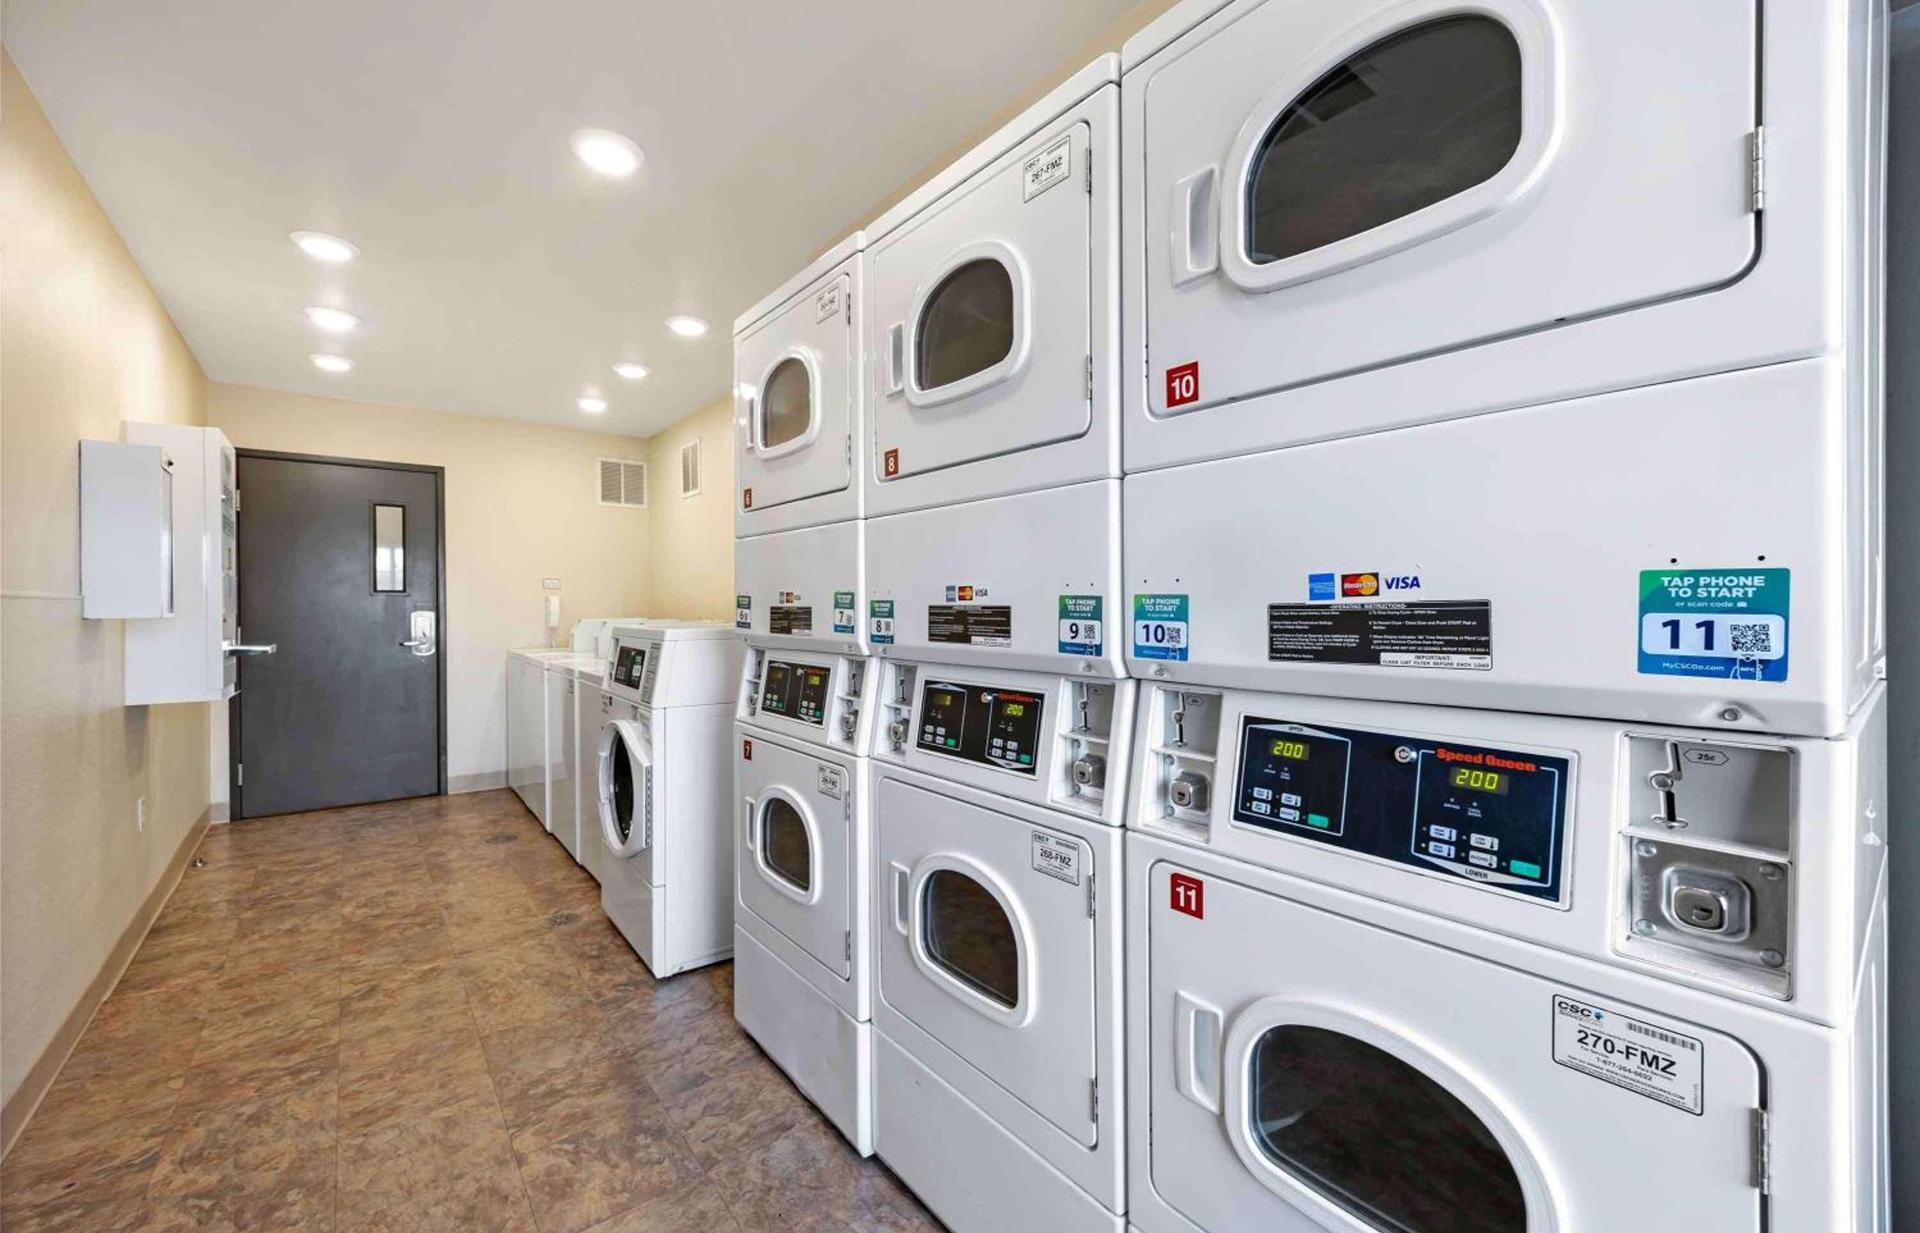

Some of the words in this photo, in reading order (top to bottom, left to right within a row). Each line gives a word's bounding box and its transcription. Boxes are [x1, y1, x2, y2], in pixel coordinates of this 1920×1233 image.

[1171, 375, 1194, 400] 10
[888, 457, 895, 472] 8
[1385, 576, 1421, 590] VISA
[1660, 576, 1695, 587] TAP
[1699, 575, 1766, 587] PHONE
[975, 588, 988, 597] VISA
[1668, 587, 1692, 598] TO
[1696, 587, 1757, 598] START
[839, 610, 844, 623] 7
[876, 619, 882, 633] 8
[1069, 622, 1079, 640] 9
[1142, 624, 1166, 643] 10
[1662, 662, 1725, 672] MyCSCGo.com
[1007, 704, 1024, 716] 200
[1273, 741, 1304, 758] 200
[1436, 748, 1484, 764] Speed
[1485, 755, 1537, 772] Queen
[1456, 768, 1499, 790] 200
[1040, 848, 1072, 867] 268-FMZ
[1465, 868, 1488, 879] LOWER
[1175, 885, 1197, 912] 11
[1557, 1001, 1593, 1017] CSC
[1576, 1029, 1677, 1077] 270-FMZ
